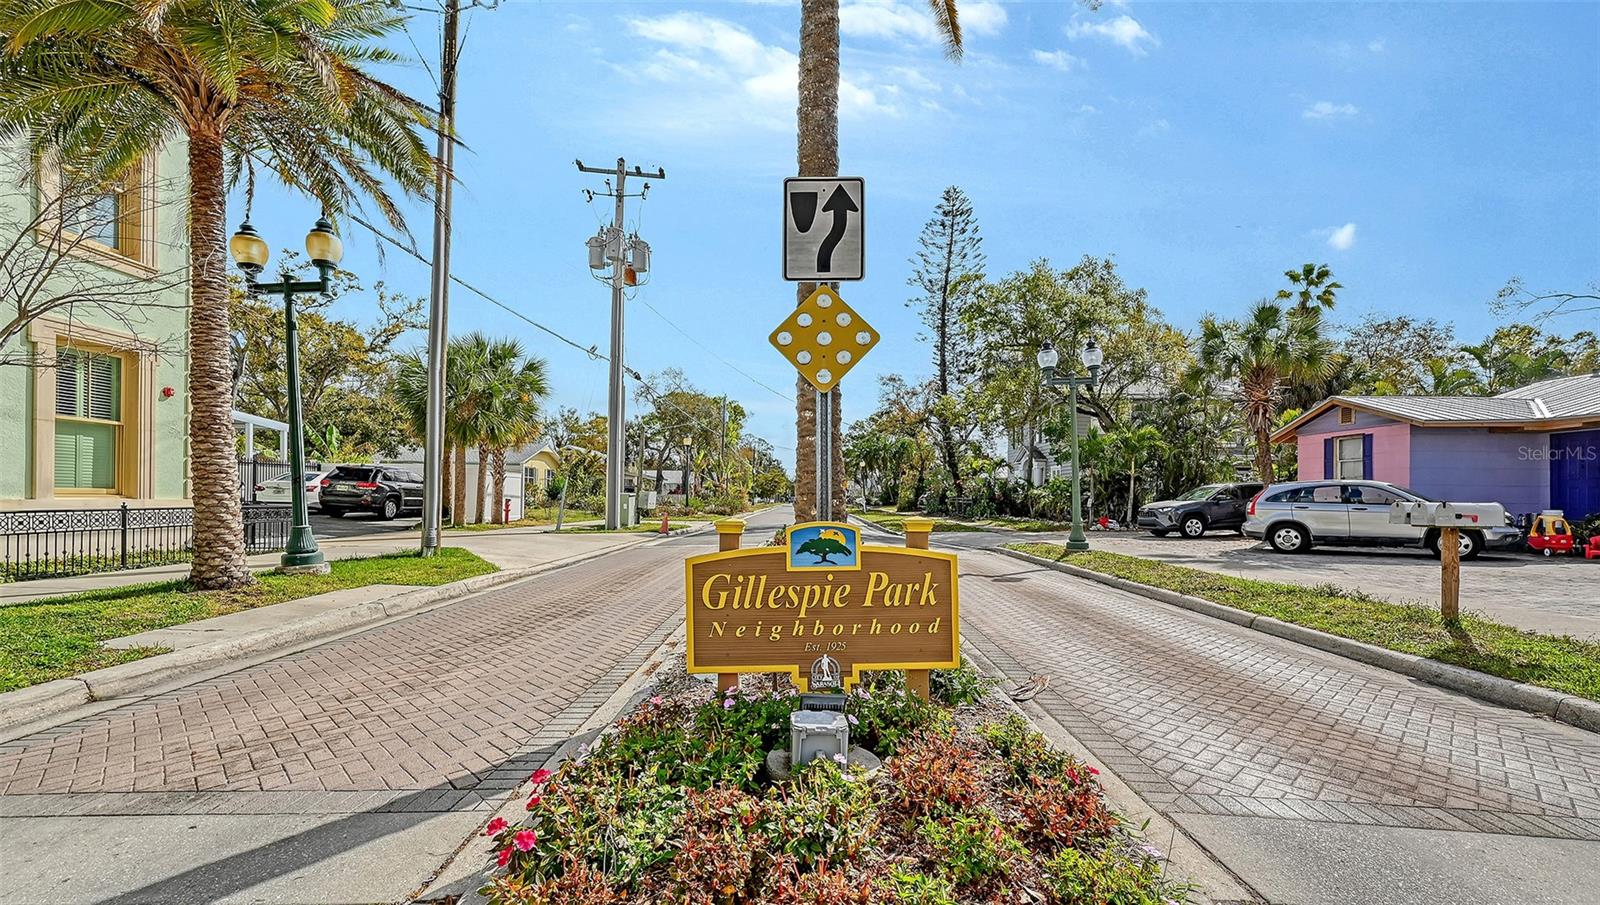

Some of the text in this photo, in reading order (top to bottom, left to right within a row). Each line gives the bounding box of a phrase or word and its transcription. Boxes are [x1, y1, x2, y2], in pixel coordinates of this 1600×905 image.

[702, 571, 939, 618] Gillespie Park
[708, 617, 941, 641] Neighborhood
[804, 641, 847, 651] Est. 1925
